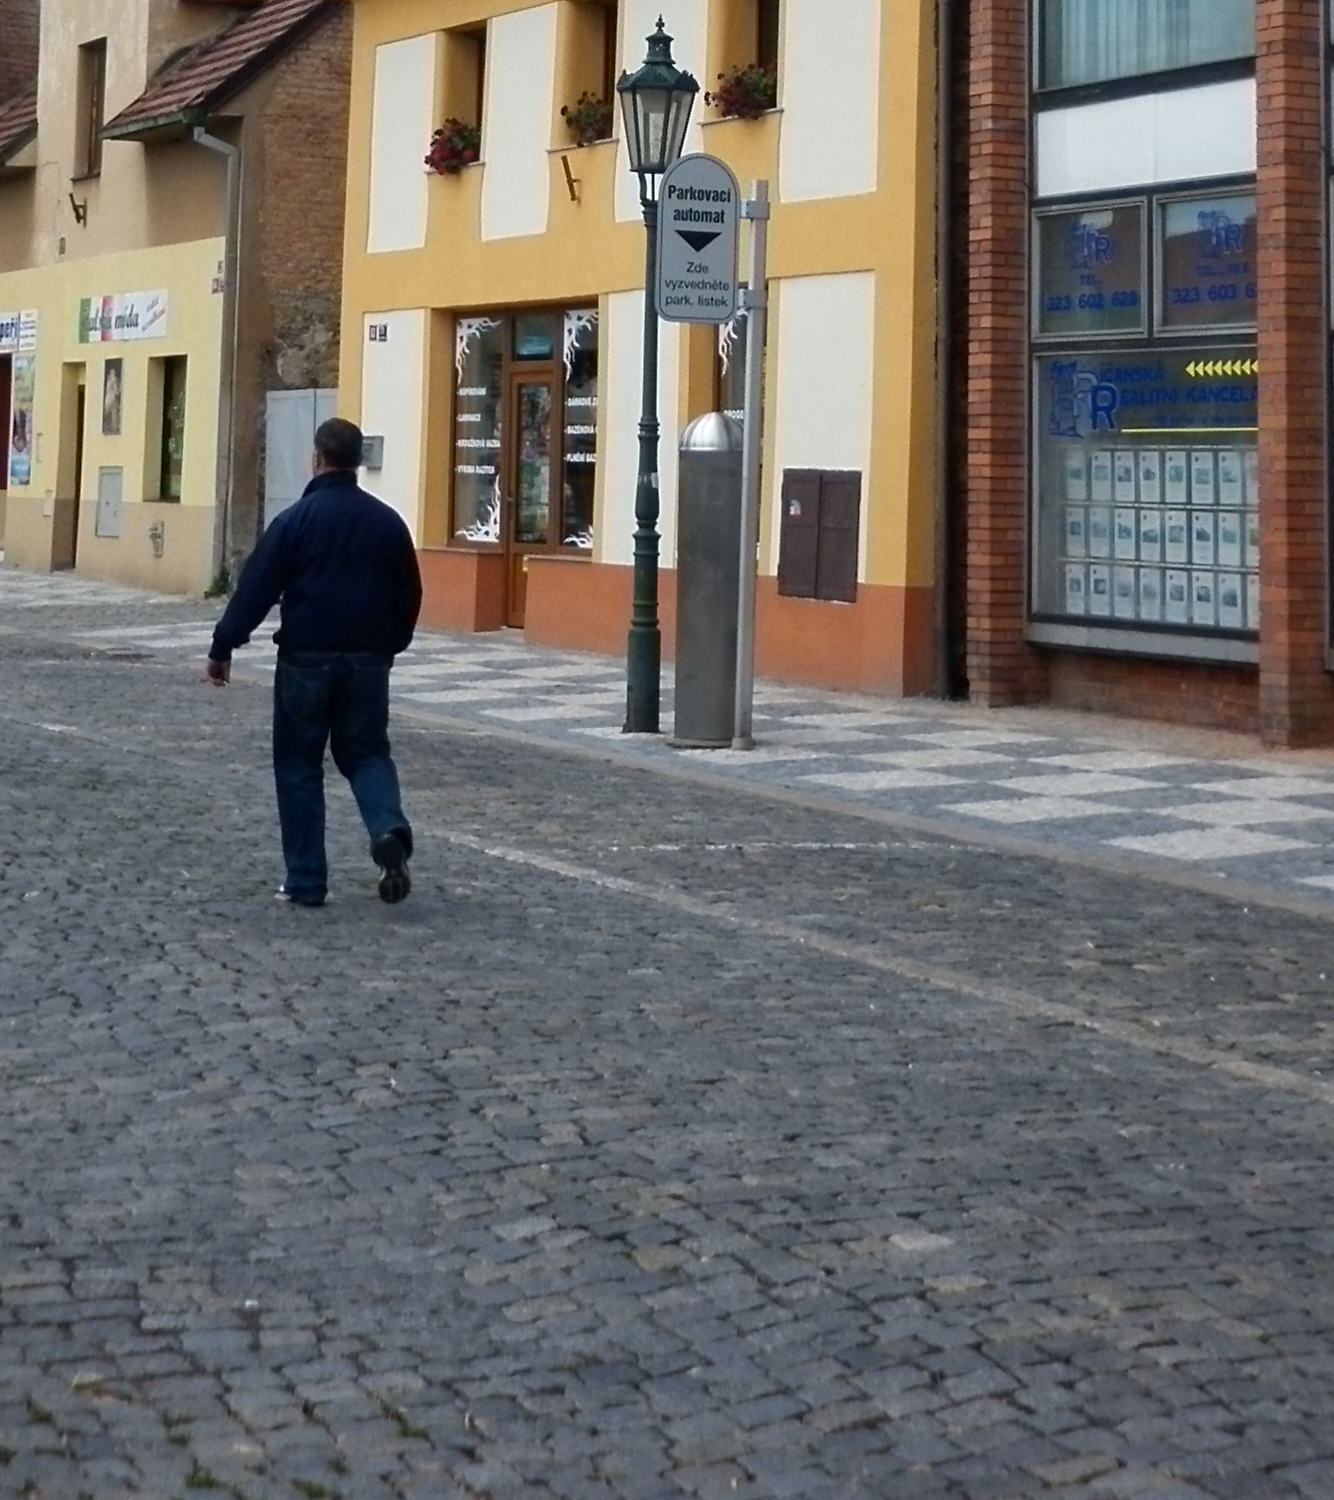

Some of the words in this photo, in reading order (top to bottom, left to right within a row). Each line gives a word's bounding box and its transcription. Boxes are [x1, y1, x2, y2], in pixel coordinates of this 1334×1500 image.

[673, 207, 725, 224] automat
[686, 261, 709, 274] Zde
[665, 295, 694, 307] park.
